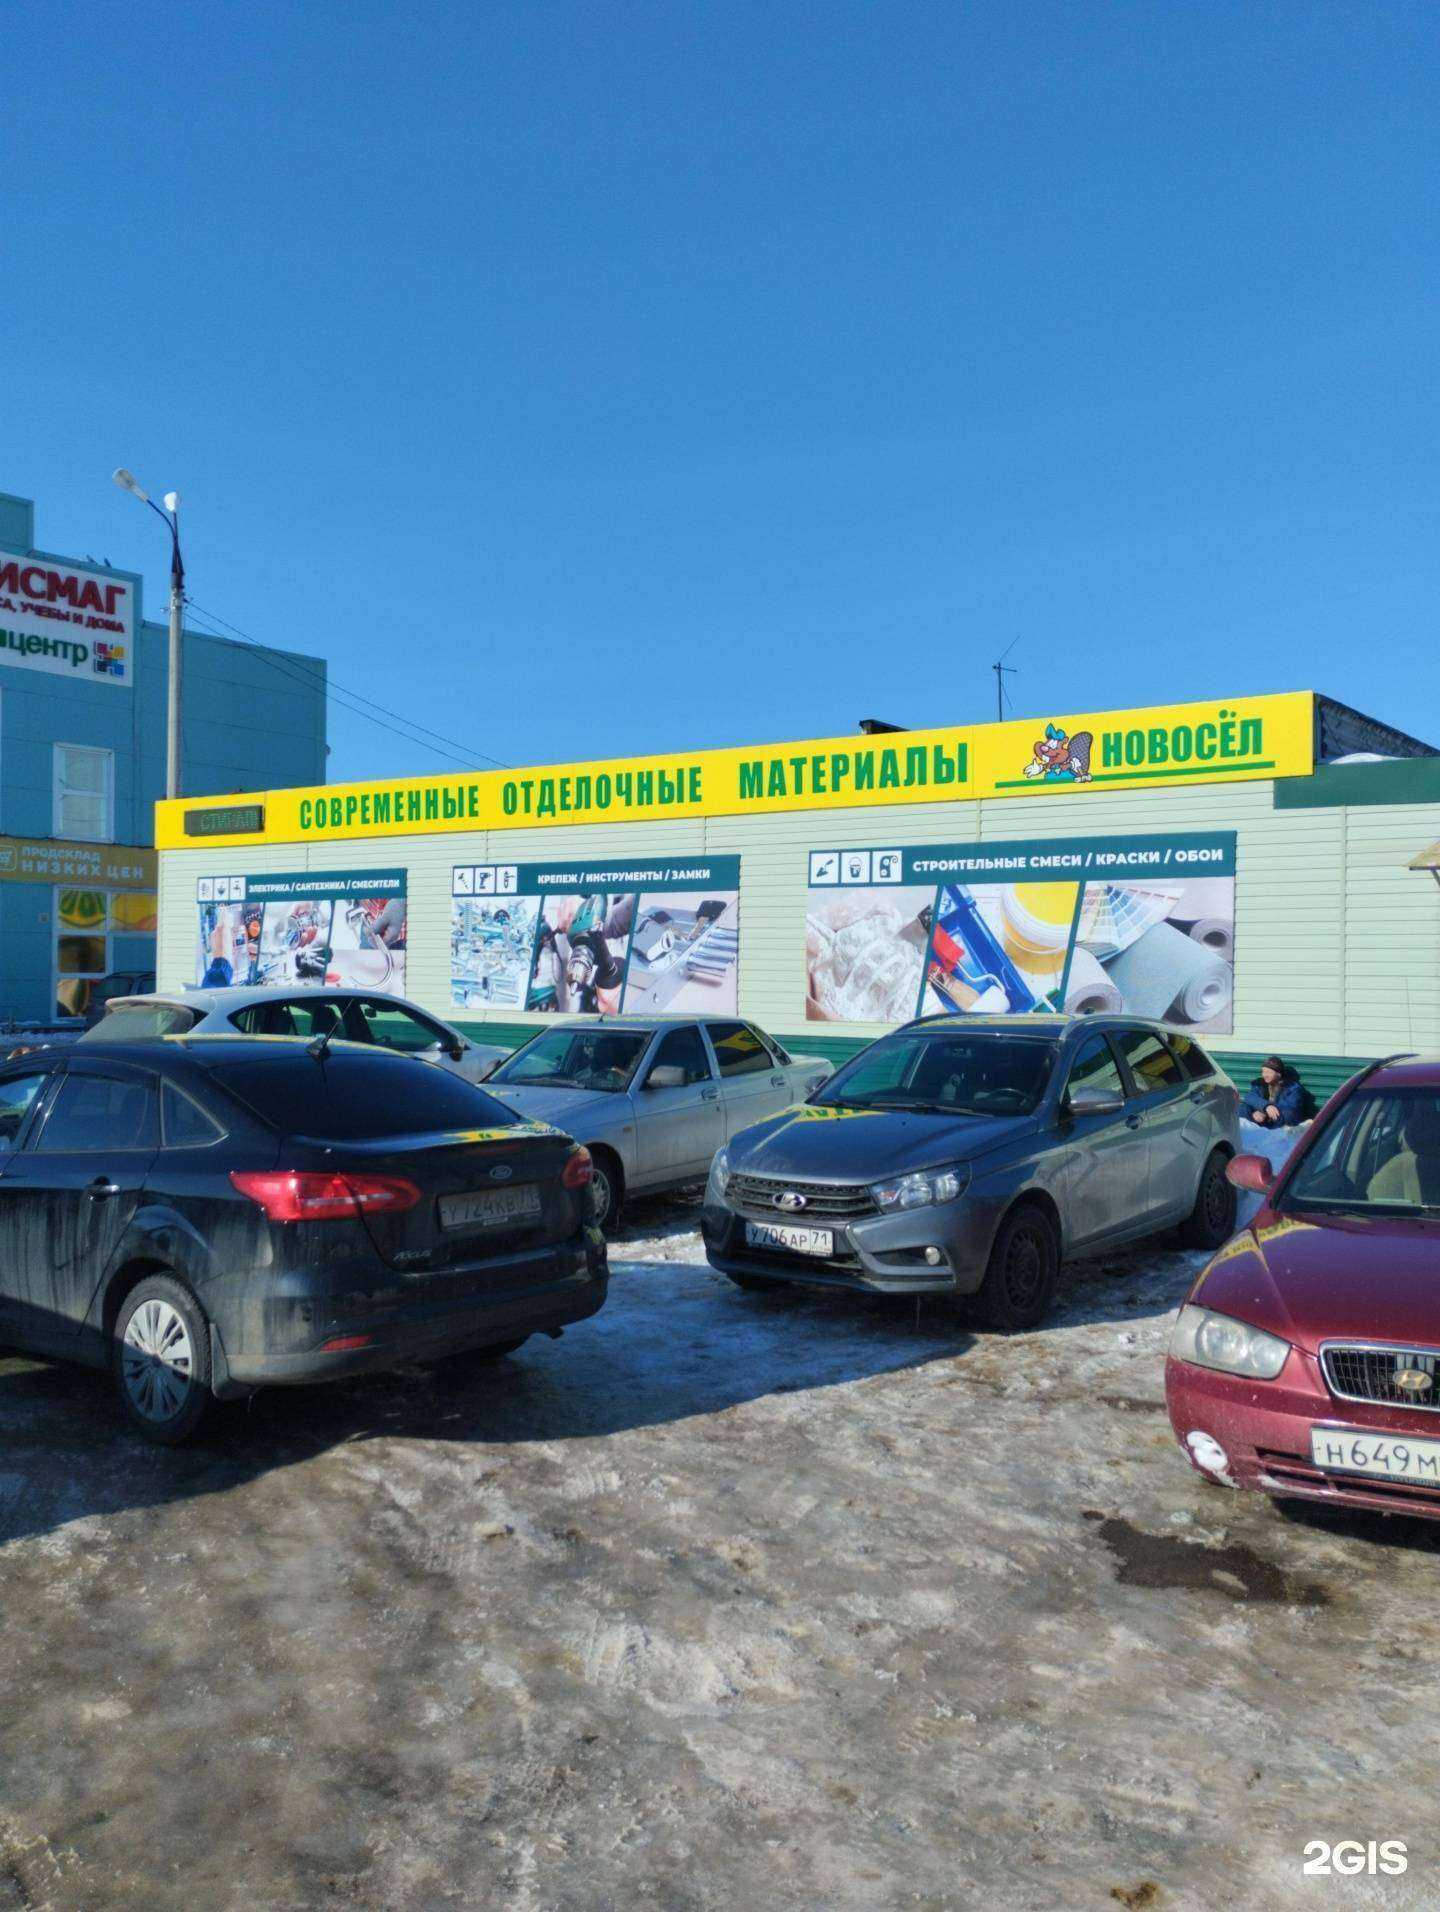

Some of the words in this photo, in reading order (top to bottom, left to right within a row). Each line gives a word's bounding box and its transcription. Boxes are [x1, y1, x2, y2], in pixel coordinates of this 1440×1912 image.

[20, 601, 70, 622] УЧЕБЫ
[72, 612, 84, 625] И
[85, 615, 125, 633] ДОМА
[1102, 709, 1264, 769] НОВОСЁЛ
[299, 785, 480, 830] СОВРЕМЕННЫЕ
[502, 766, 702, 817] ОТДЕЛОЧНЫЕ
[738, 742, 968, 799] МАТЕРИАЛЫ
[22, 846, 102, 862] ПРОДСКЛАД
[912, 857, 1027, 872] СТРОИТЕЛЬНЫЕ
[1029, 854, 1082, 868] СМЕСИ
[1095, 851, 1160, 866] КРАСКИ
[1174, 848, 1223, 862] ОБОИ
[21, 860, 101, 877] НИЗКИХ
[107, 865, 144, 879] ЦЕН
[537, 873, 578, 884] КРЕПЕЖ
[585, 870, 663, 883] ИНСТРУМЕНТЫ
[672, 868, 711, 880] ЗАМКИ
[248, 883, 291, 893] ЭЛЕКТРИКА
[295, 881, 345, 891] САНТЕХНИКА
[351, 879, 400, 889] СМЕСИТЕЛИ
